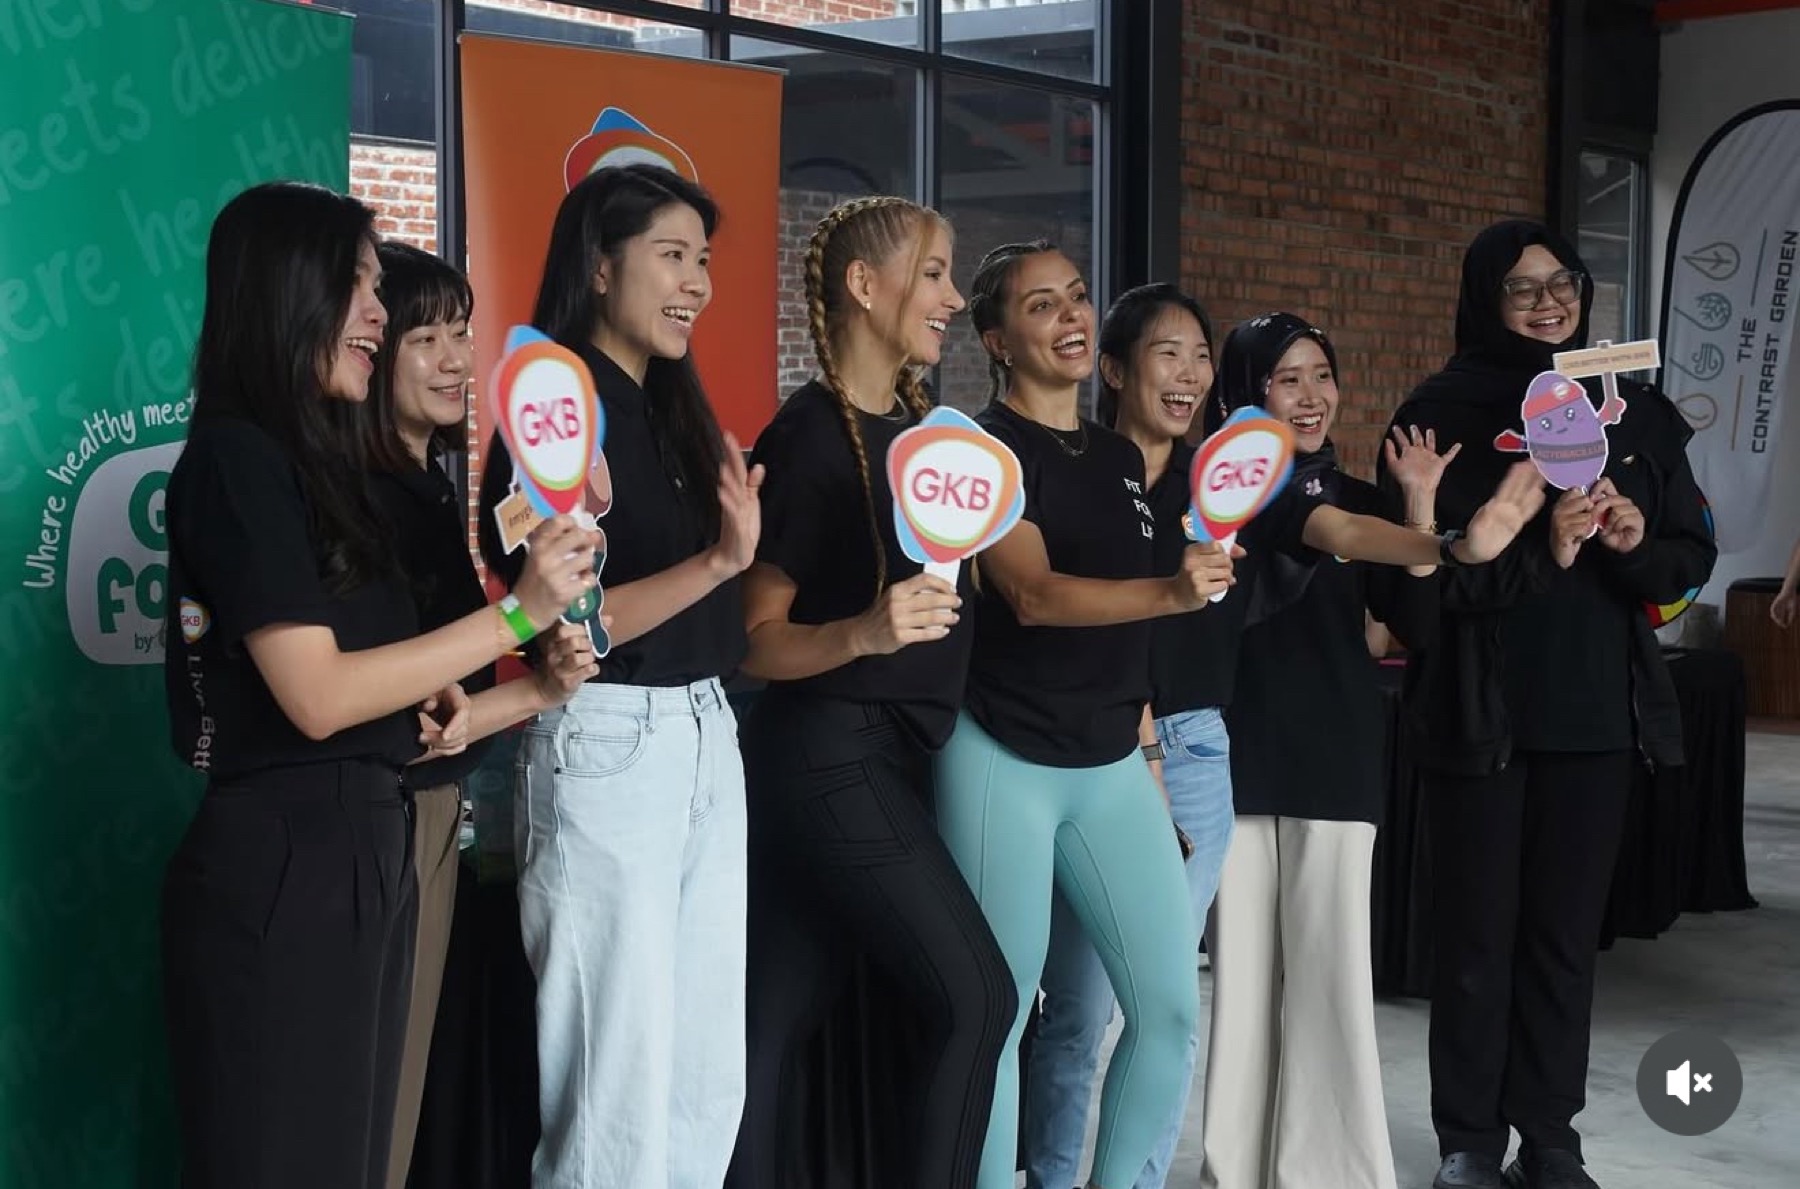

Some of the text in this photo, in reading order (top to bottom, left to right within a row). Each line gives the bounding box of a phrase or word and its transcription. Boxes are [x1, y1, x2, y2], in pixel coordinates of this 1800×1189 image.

[1737, 317, 1756, 363] THE
[1751, 230, 1800, 454] CONTRAST GARDEN
[518, 396, 580, 447] GKB
[912, 467, 991, 511] GKB
[1208, 456, 1269, 492] GKB
[23, 495, 67, 589] Where
[46, 408, 137, 486] healthy
[134, 633, 154, 654] by
